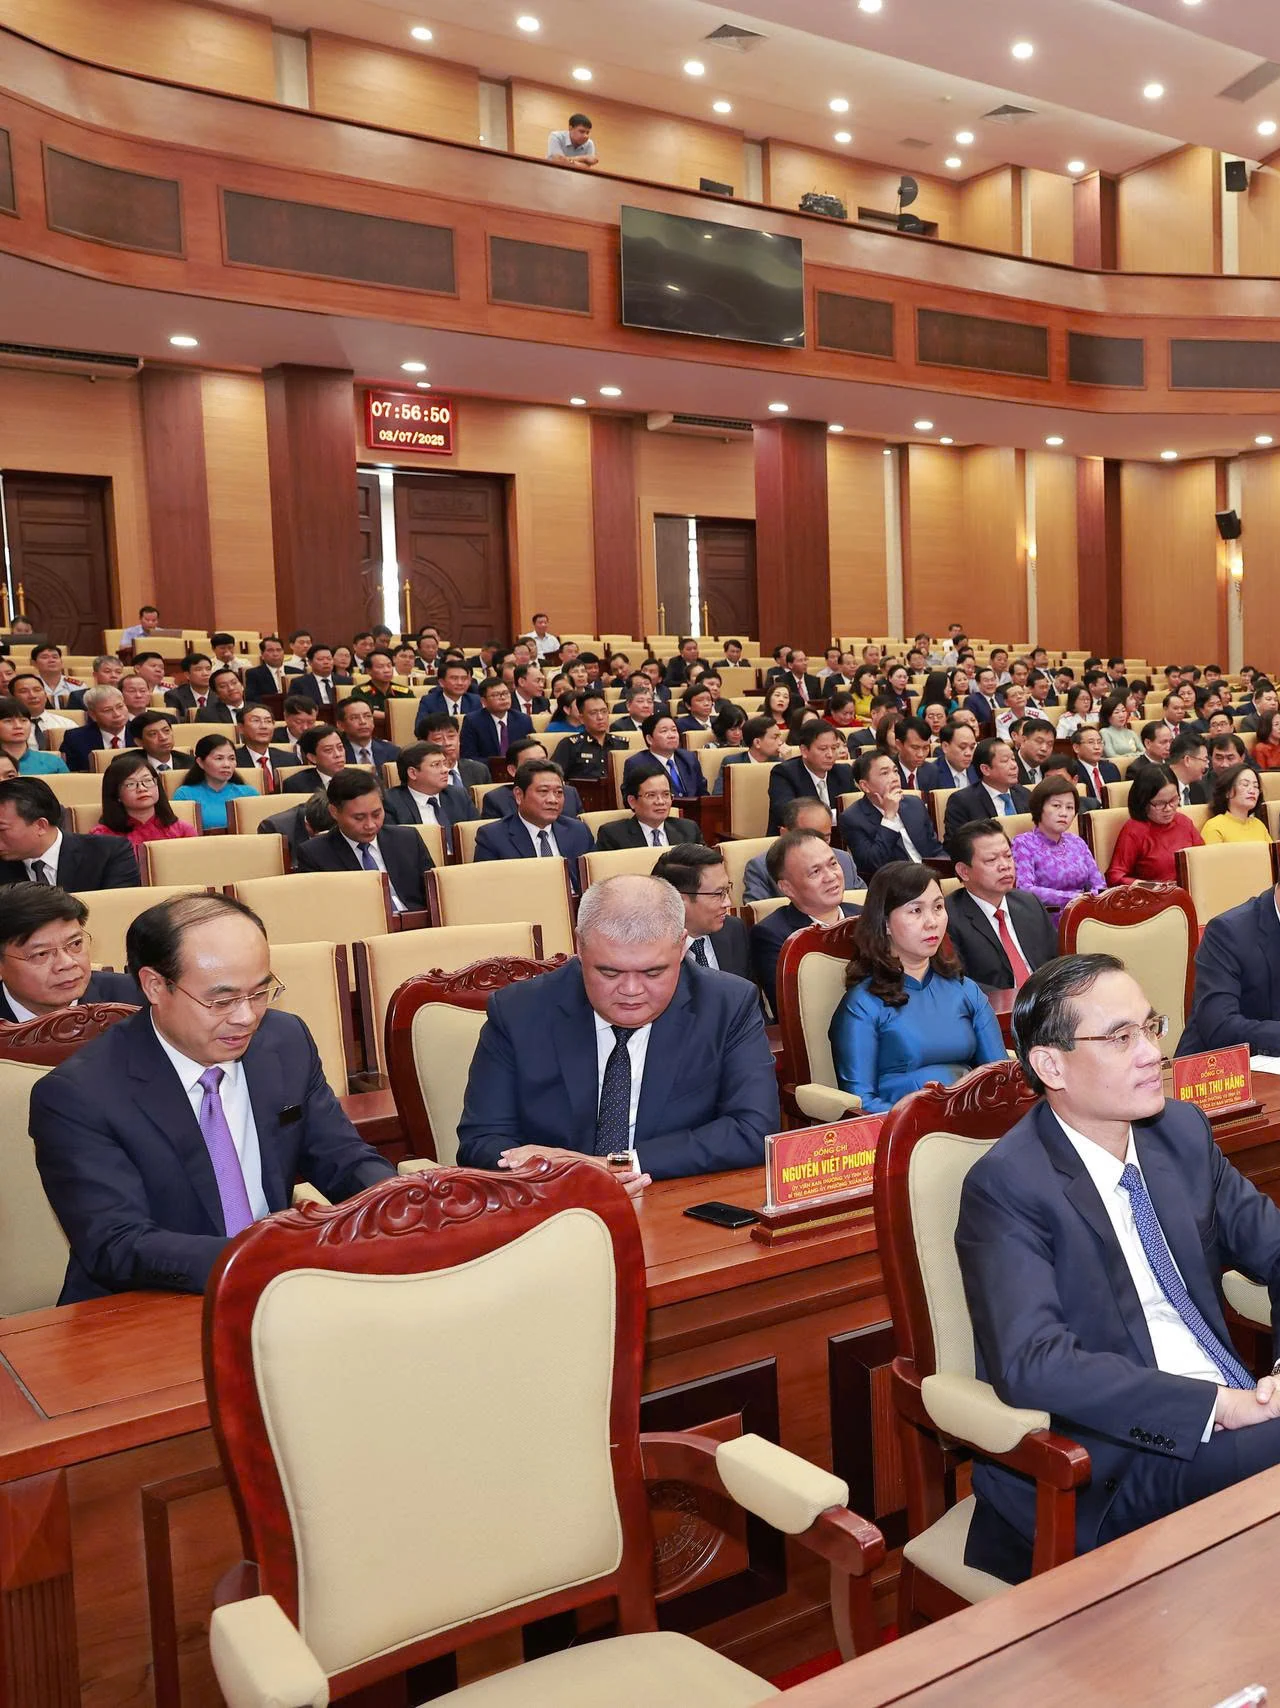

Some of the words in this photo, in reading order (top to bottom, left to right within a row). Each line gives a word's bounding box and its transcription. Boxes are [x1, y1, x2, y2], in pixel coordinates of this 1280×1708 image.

[371, 401, 450, 423] 07:56:50
[1180, 1084, 1193, 1101] BÙI
[1195, 1082, 1207, 1098] THỊ
[1209, 1079, 1223, 1094] THU
[813, 1145, 835, 1157] ĐỒNG
[835, 1143, 848, 1152] CHÍ
[782, 1157, 819, 1184] NGUYỄN
[821, 1155, 840, 1176] VIỆT
